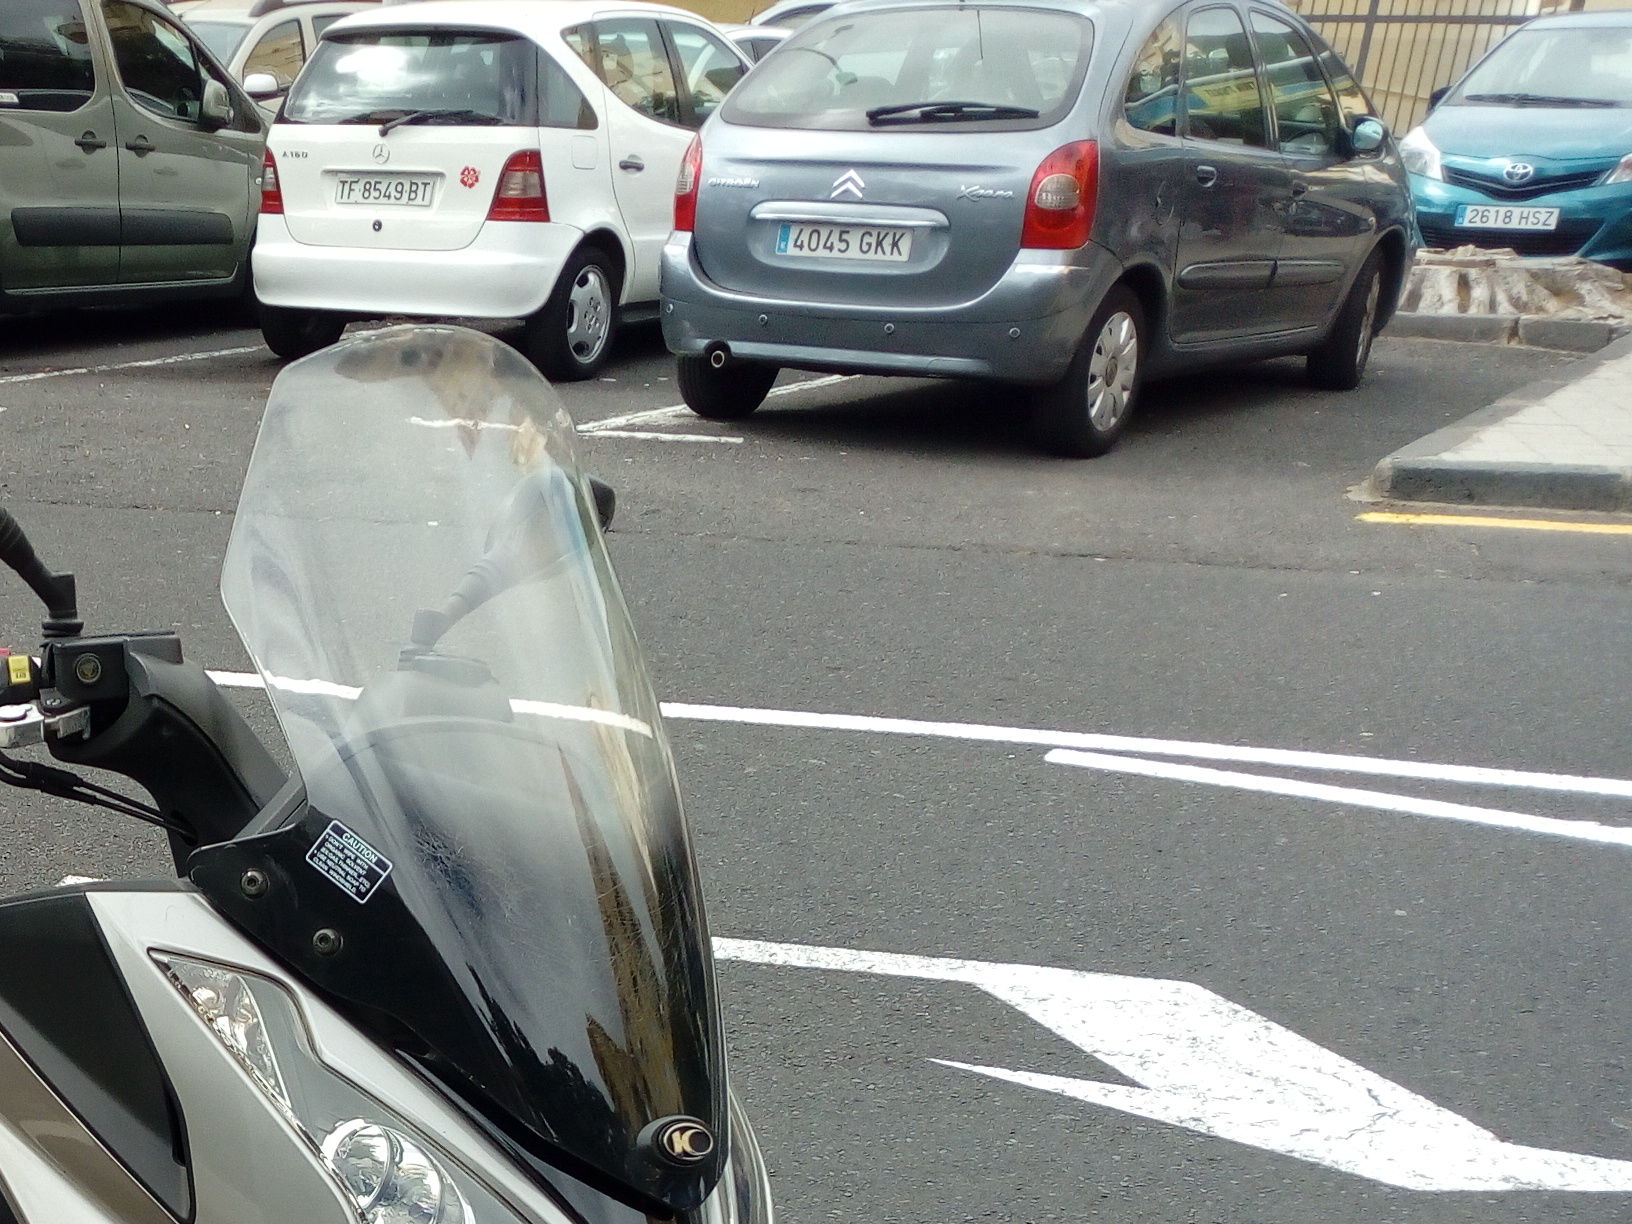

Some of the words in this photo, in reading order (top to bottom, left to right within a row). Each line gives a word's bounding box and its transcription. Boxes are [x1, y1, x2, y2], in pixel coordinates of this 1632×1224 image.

[1468, 208, 1513, 224] 2618
[1518, 211, 1554, 226] HSZ
[793, 228, 850, 253] 4045
[859, 231, 908, 257] GKK
[342, 832, 378, 863] CAUTION
[346, 858, 366, 876] SOLVENT
